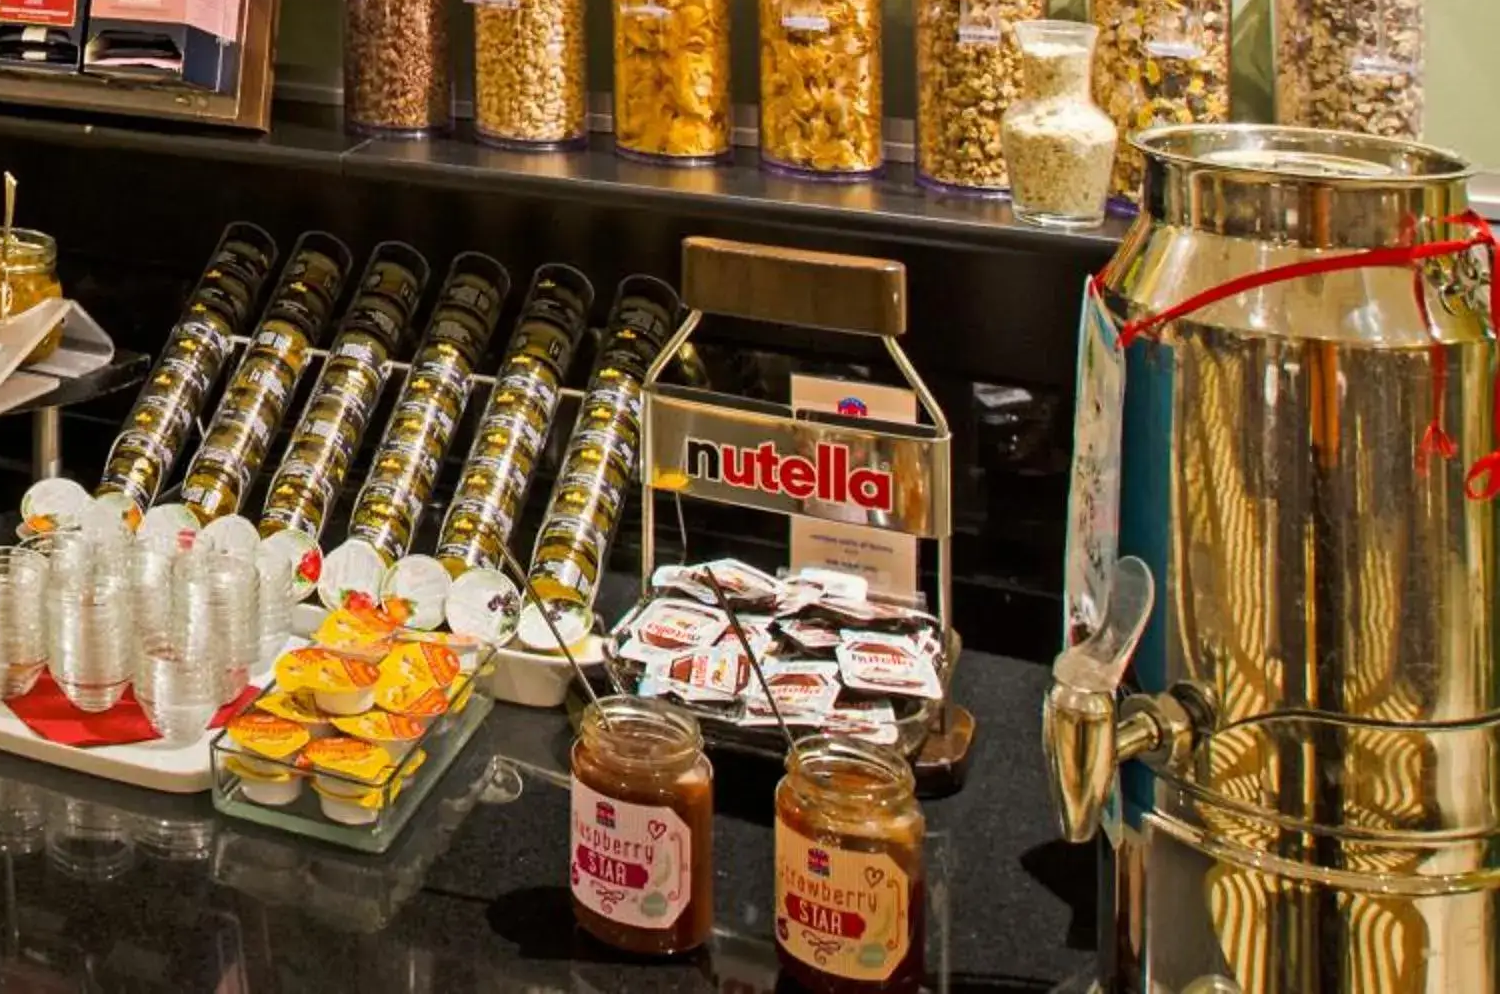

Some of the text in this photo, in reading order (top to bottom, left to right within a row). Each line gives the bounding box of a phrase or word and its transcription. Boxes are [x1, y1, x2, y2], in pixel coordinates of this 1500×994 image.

[686, 436, 894, 513] nutella
[587, 851, 626, 887] STAR
[799, 899, 842, 935] STAR
